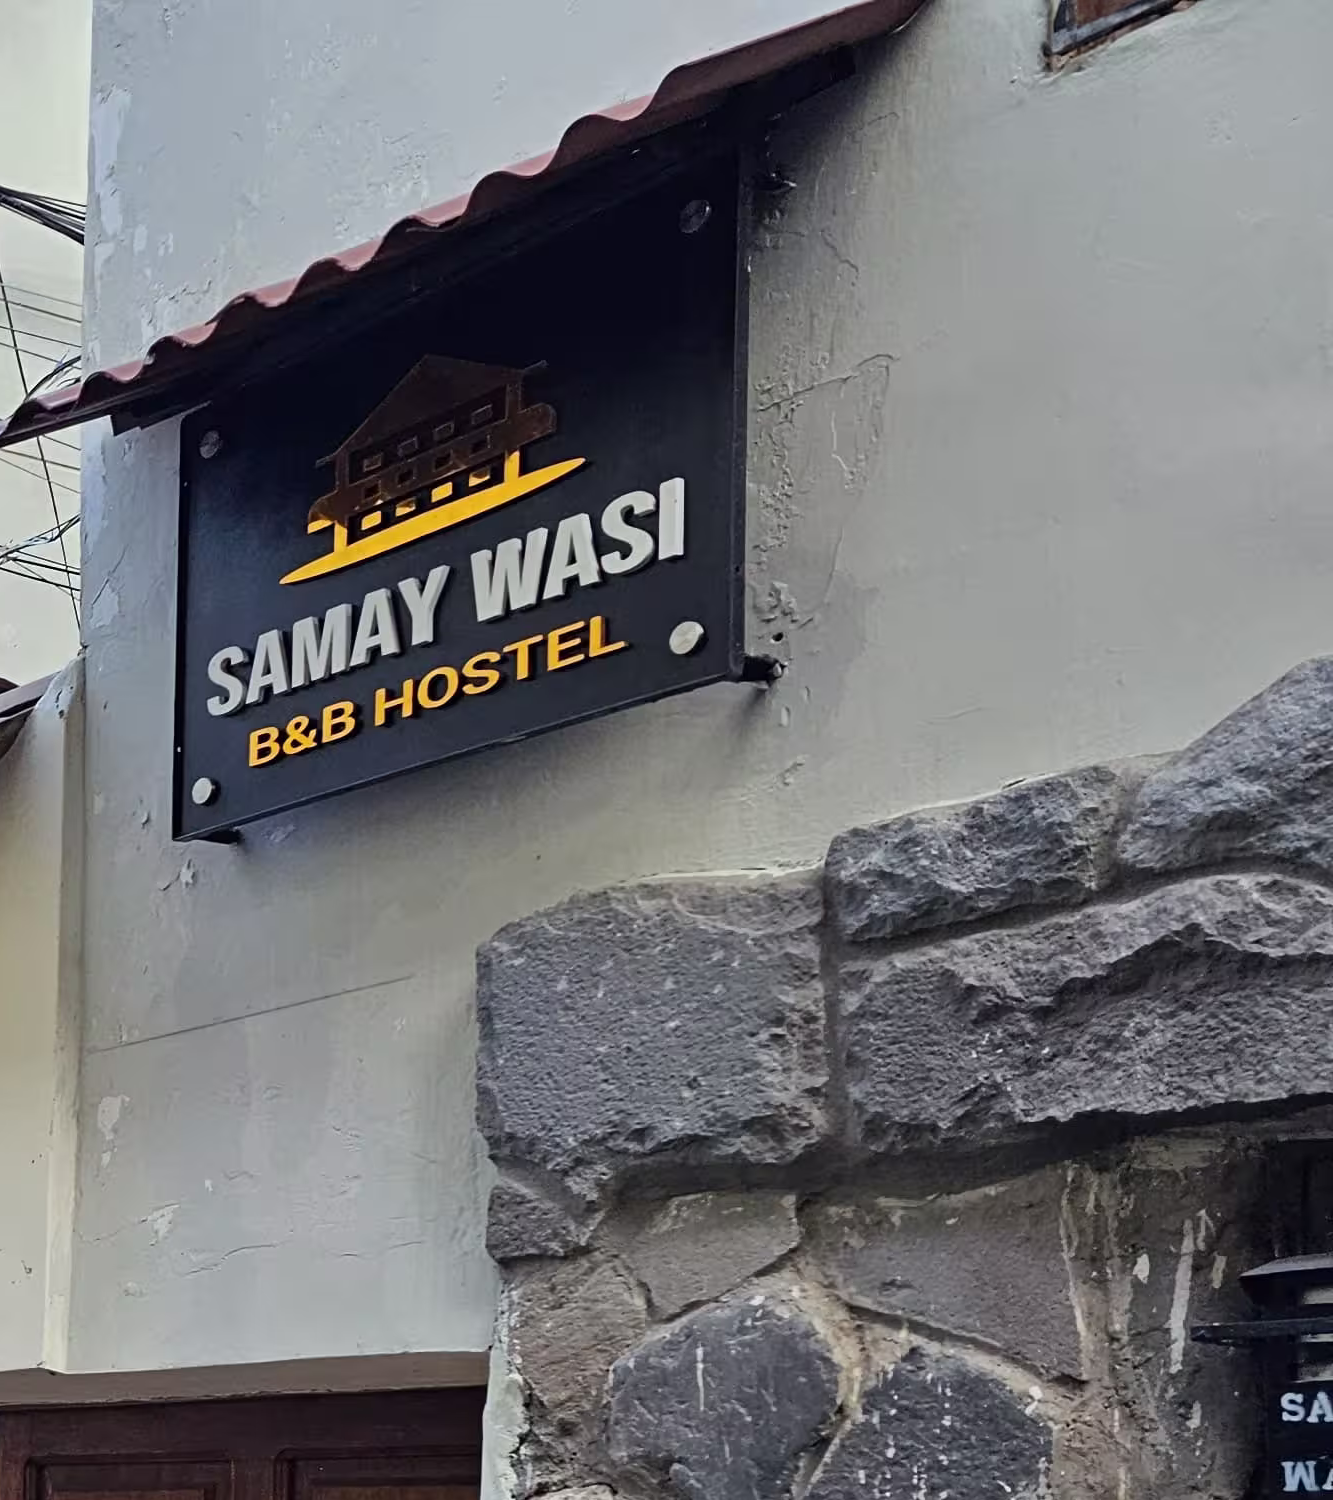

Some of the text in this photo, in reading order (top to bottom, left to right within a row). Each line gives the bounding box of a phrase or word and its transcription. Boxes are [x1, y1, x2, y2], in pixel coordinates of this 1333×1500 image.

[207, 477, 685, 717] SAMAY WASI
[248, 615, 628, 768] B&B HOSTEL
